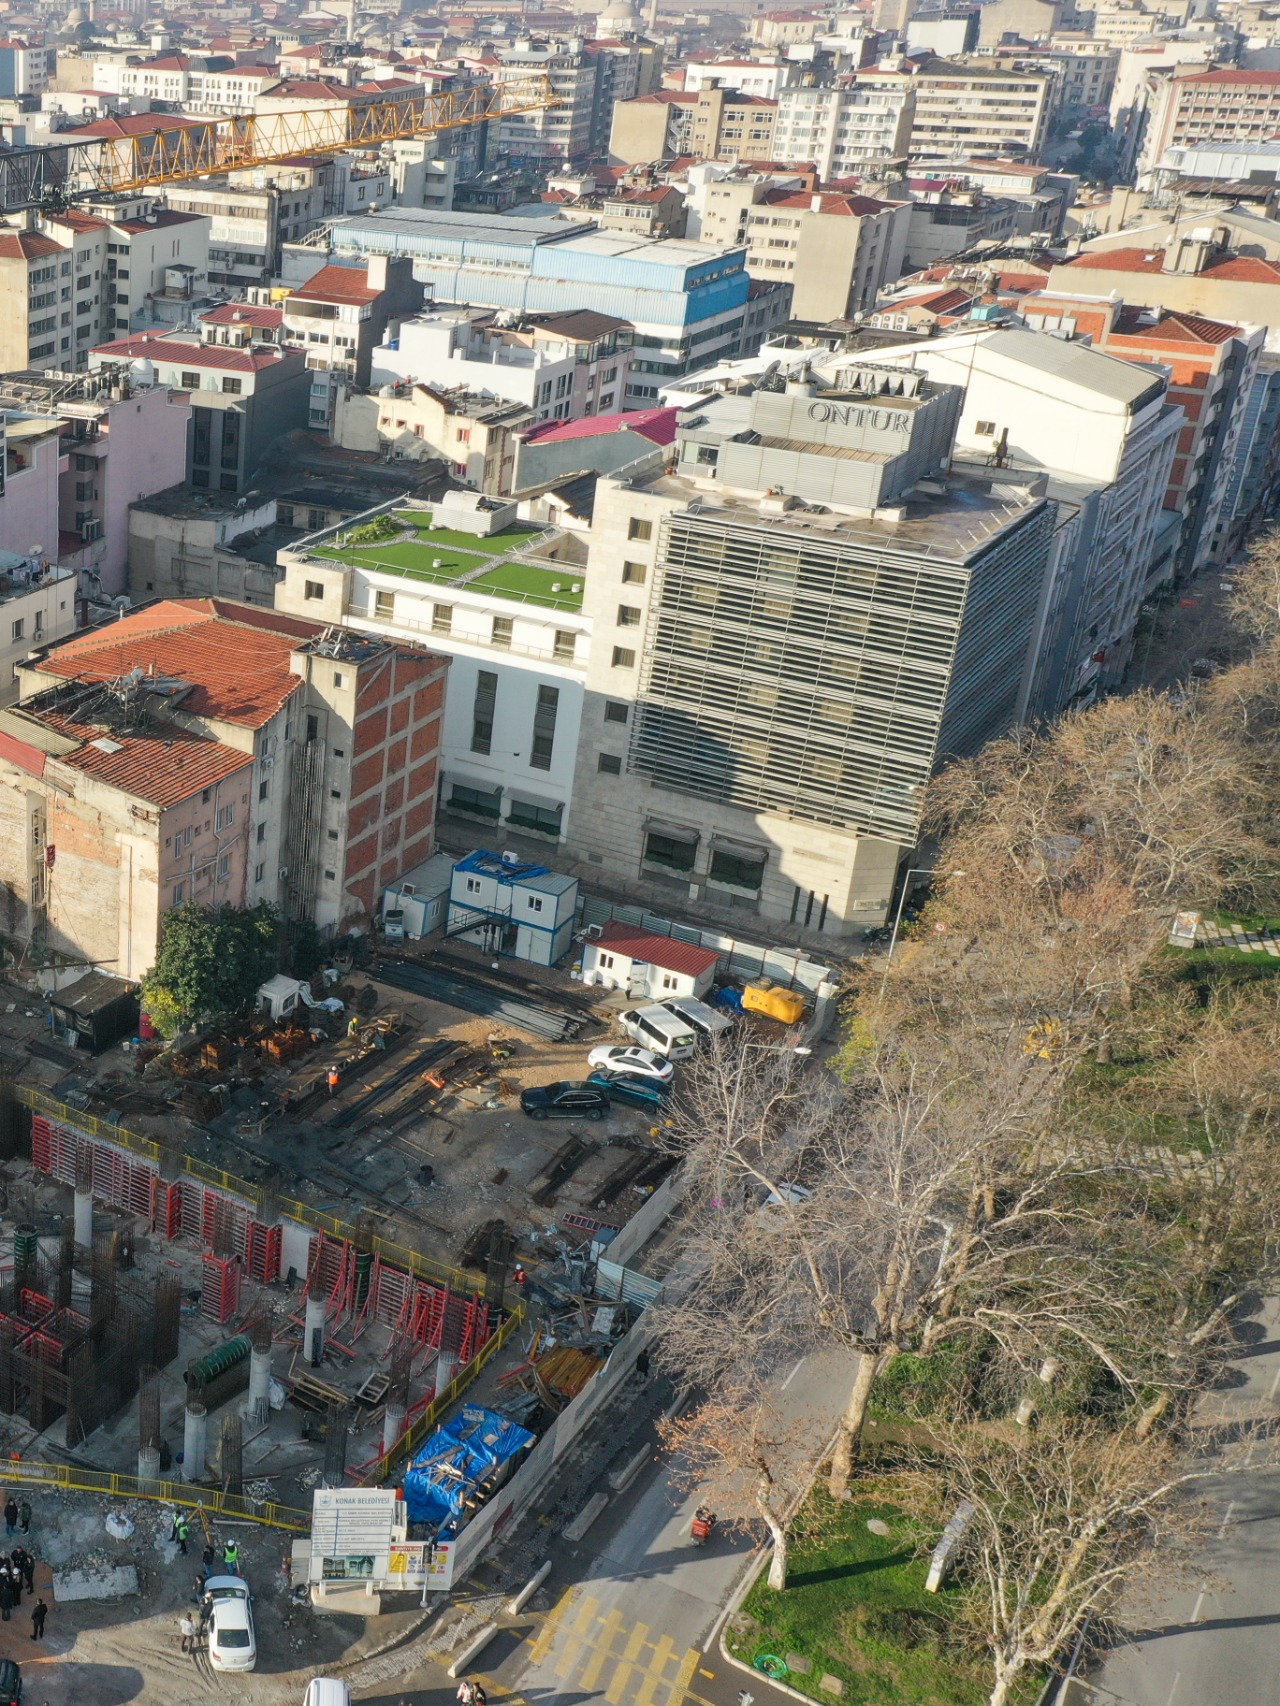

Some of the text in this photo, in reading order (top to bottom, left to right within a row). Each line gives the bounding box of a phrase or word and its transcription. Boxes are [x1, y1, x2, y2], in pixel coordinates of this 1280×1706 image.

[808, 402, 909, 434] ONTUR
[335, 1496, 390, 1505] KONAK BELEDİYESİ
